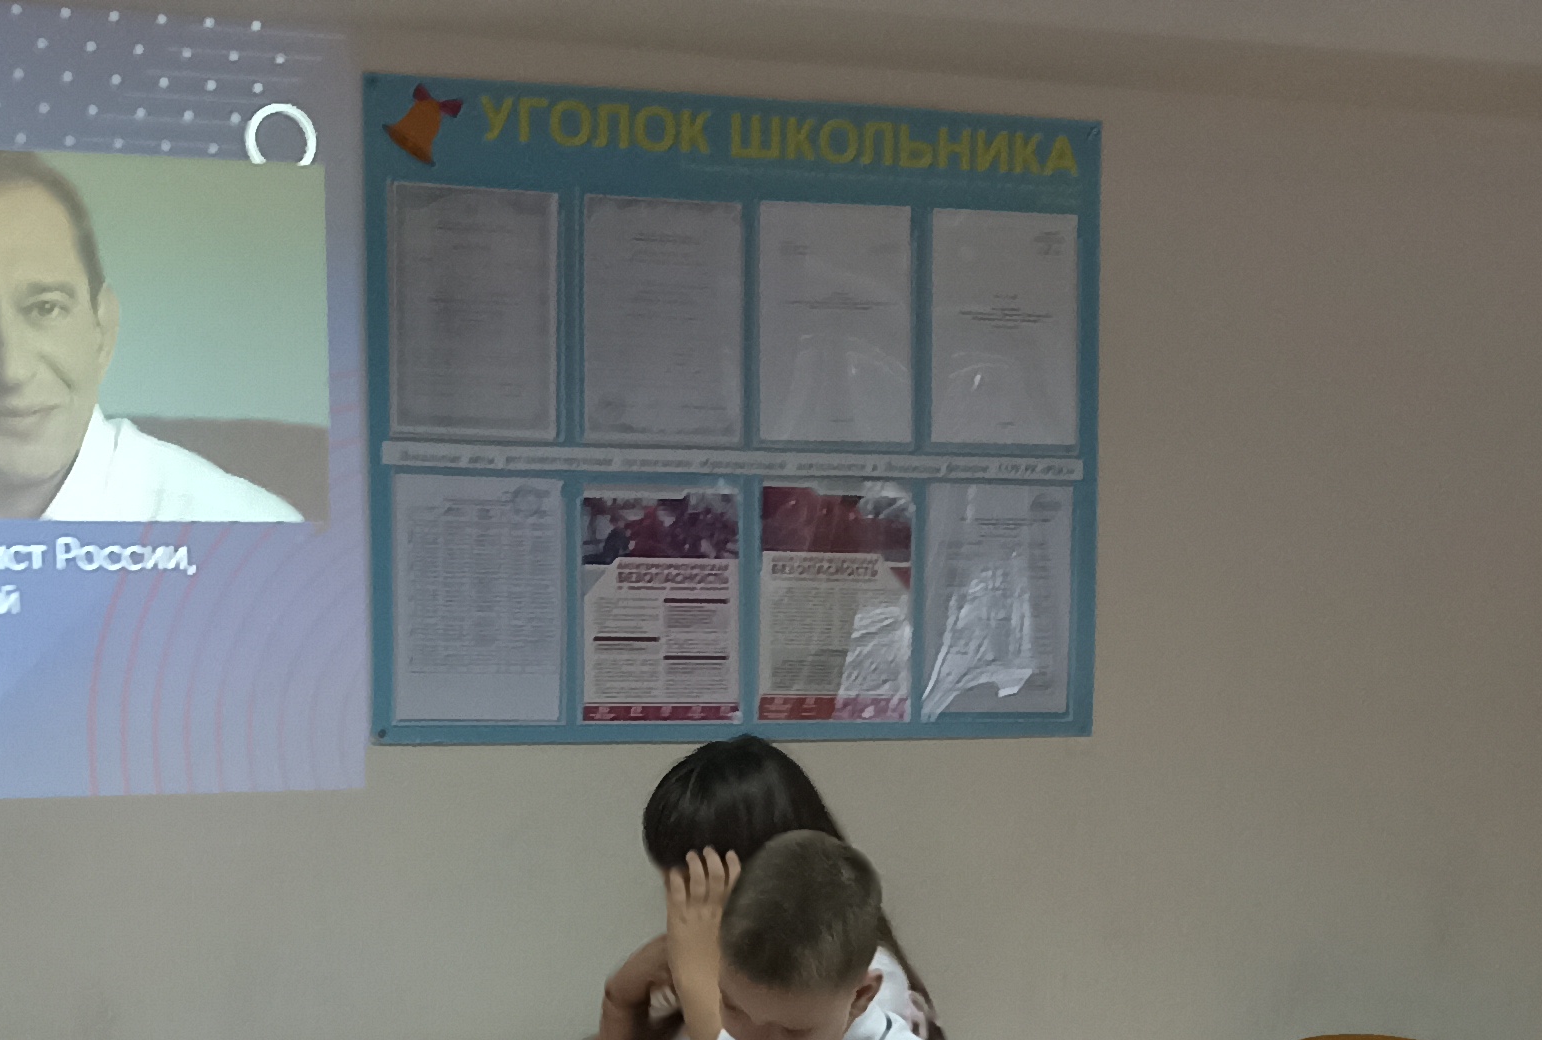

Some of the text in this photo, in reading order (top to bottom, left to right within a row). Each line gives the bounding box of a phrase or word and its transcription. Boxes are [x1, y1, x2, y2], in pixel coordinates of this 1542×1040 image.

[481, 96, 712, 154] УГОЛОК
[730, 112, 1079, 177] ШКОЛЬНИКА
[56, 536, 196, 575] России,
